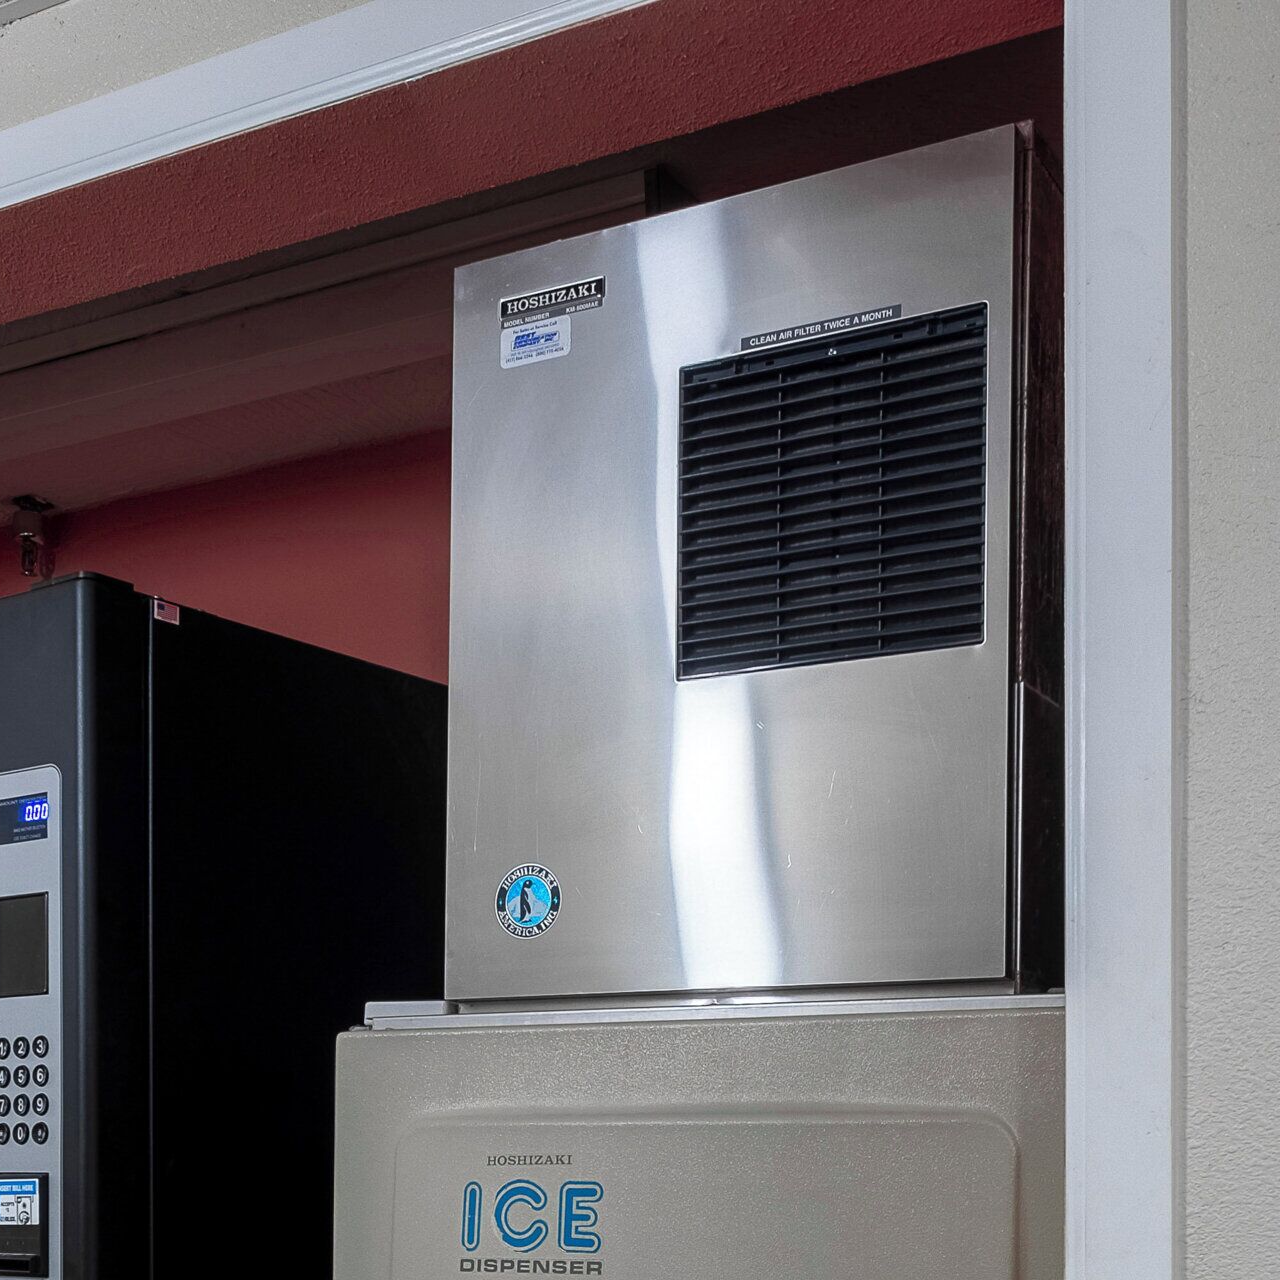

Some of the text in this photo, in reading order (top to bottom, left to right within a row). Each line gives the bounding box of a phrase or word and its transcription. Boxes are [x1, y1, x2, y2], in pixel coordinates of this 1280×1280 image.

[506, 282, 598, 315] HOSHIZAKI
[503, 312, 550, 329] MODEL NUMBER
[749, 308, 893, 346] CLEAN AIR FILTER TWICE A MONTH
[502, 866, 557, 890] HOSHIZAKI
[17, 1040, 25, 1055] 2
[36, 1039, 44, 1054] 3
[17, 1069, 24, 1083] 5
[36, 1068, 44, 1083] 6
[17, 1098, 24, 1112] 8
[36, 1098, 44, 1112] 9
[17, 1126, 23, 1141] 0
[486, 1154, 573, 1166] HOSHIZAKI
[461, 1178, 604, 1253] ICE
[459, 1258, 603, 1275] DISPENSER
